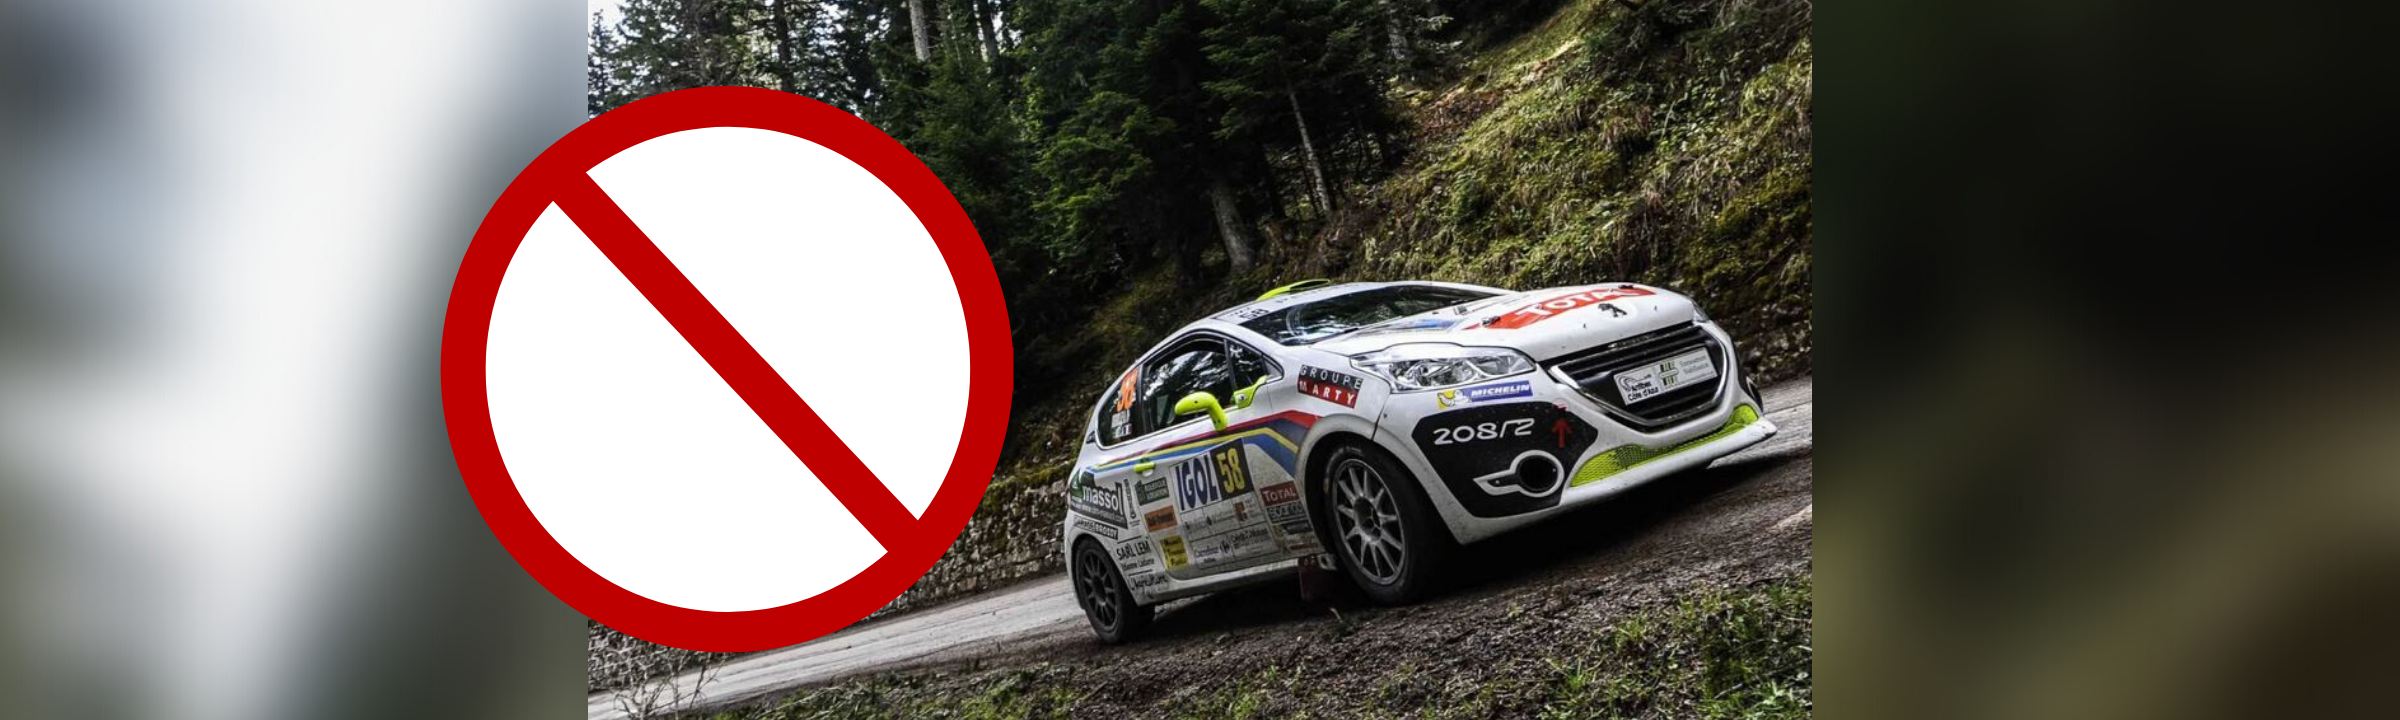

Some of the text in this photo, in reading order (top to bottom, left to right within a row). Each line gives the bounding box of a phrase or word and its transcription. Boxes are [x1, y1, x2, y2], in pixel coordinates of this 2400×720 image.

[1300, 365, 1362, 390] GROUPE
[1299, 380, 1355, 405] MARTY
[1471, 384, 1531, 397] MICHELIN
[1175, 454, 1219, 511] IGOL
[1216, 448, 1245, 493] 58
[1082, 485, 1123, 516] massol
[1262, 487, 1296, 502] TOTAL
